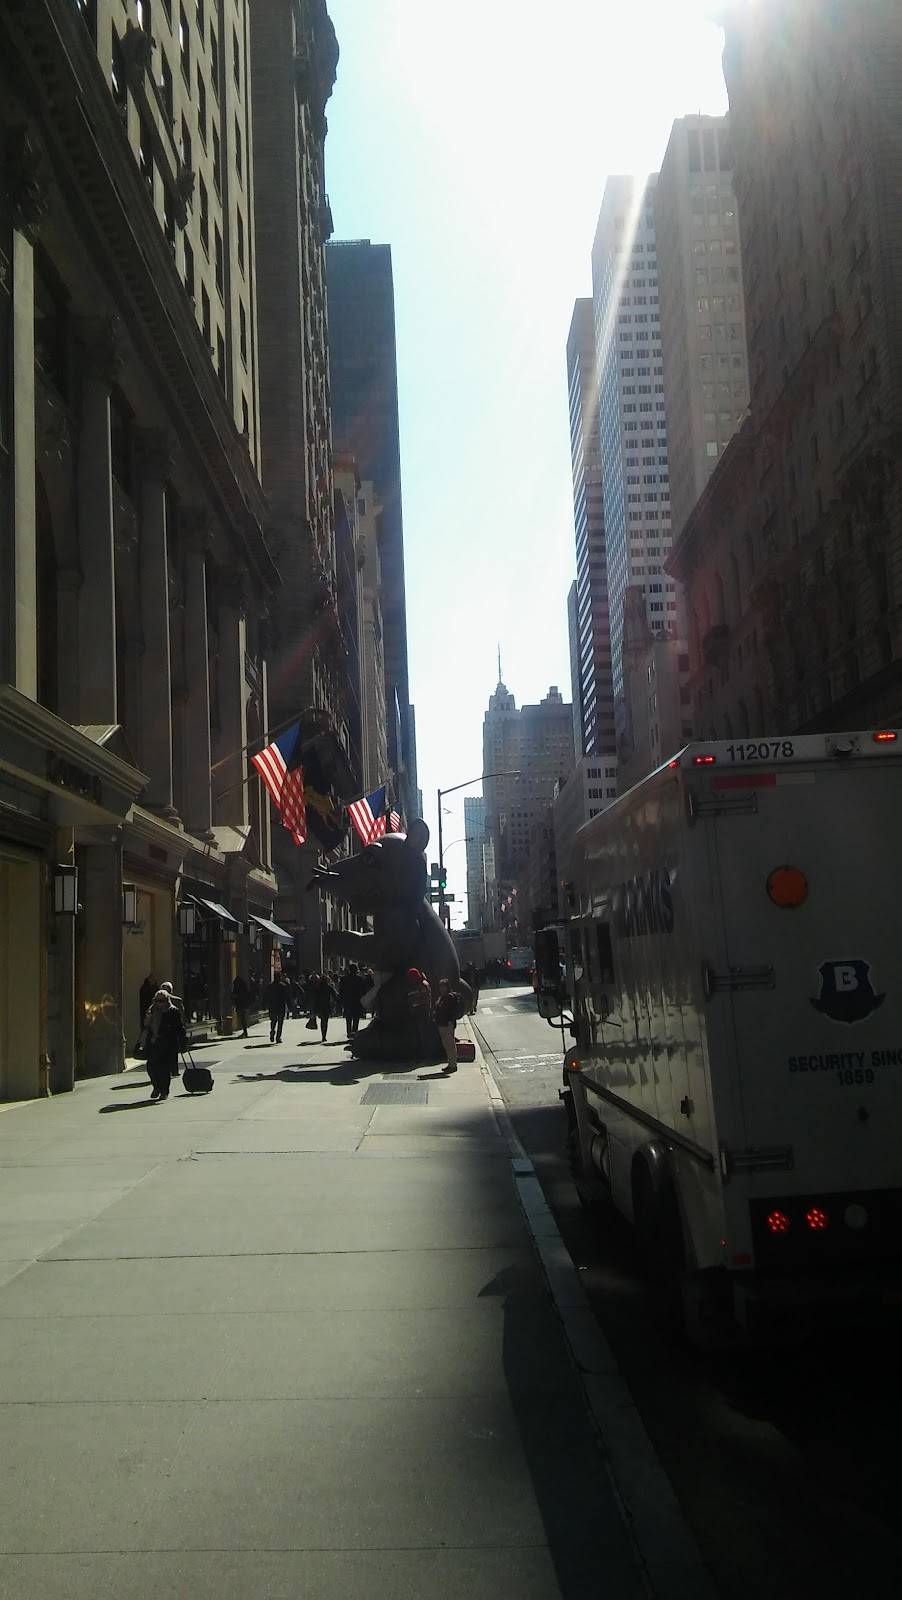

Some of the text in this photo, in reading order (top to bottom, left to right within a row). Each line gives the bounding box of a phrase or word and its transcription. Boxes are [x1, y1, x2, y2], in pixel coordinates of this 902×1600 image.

[726, 741, 794, 761] 112078
[833, 965, 858, 992] B
[788, 1052, 865, 1072] SECURITY
[838, 1068, 875, 1086] 1859
